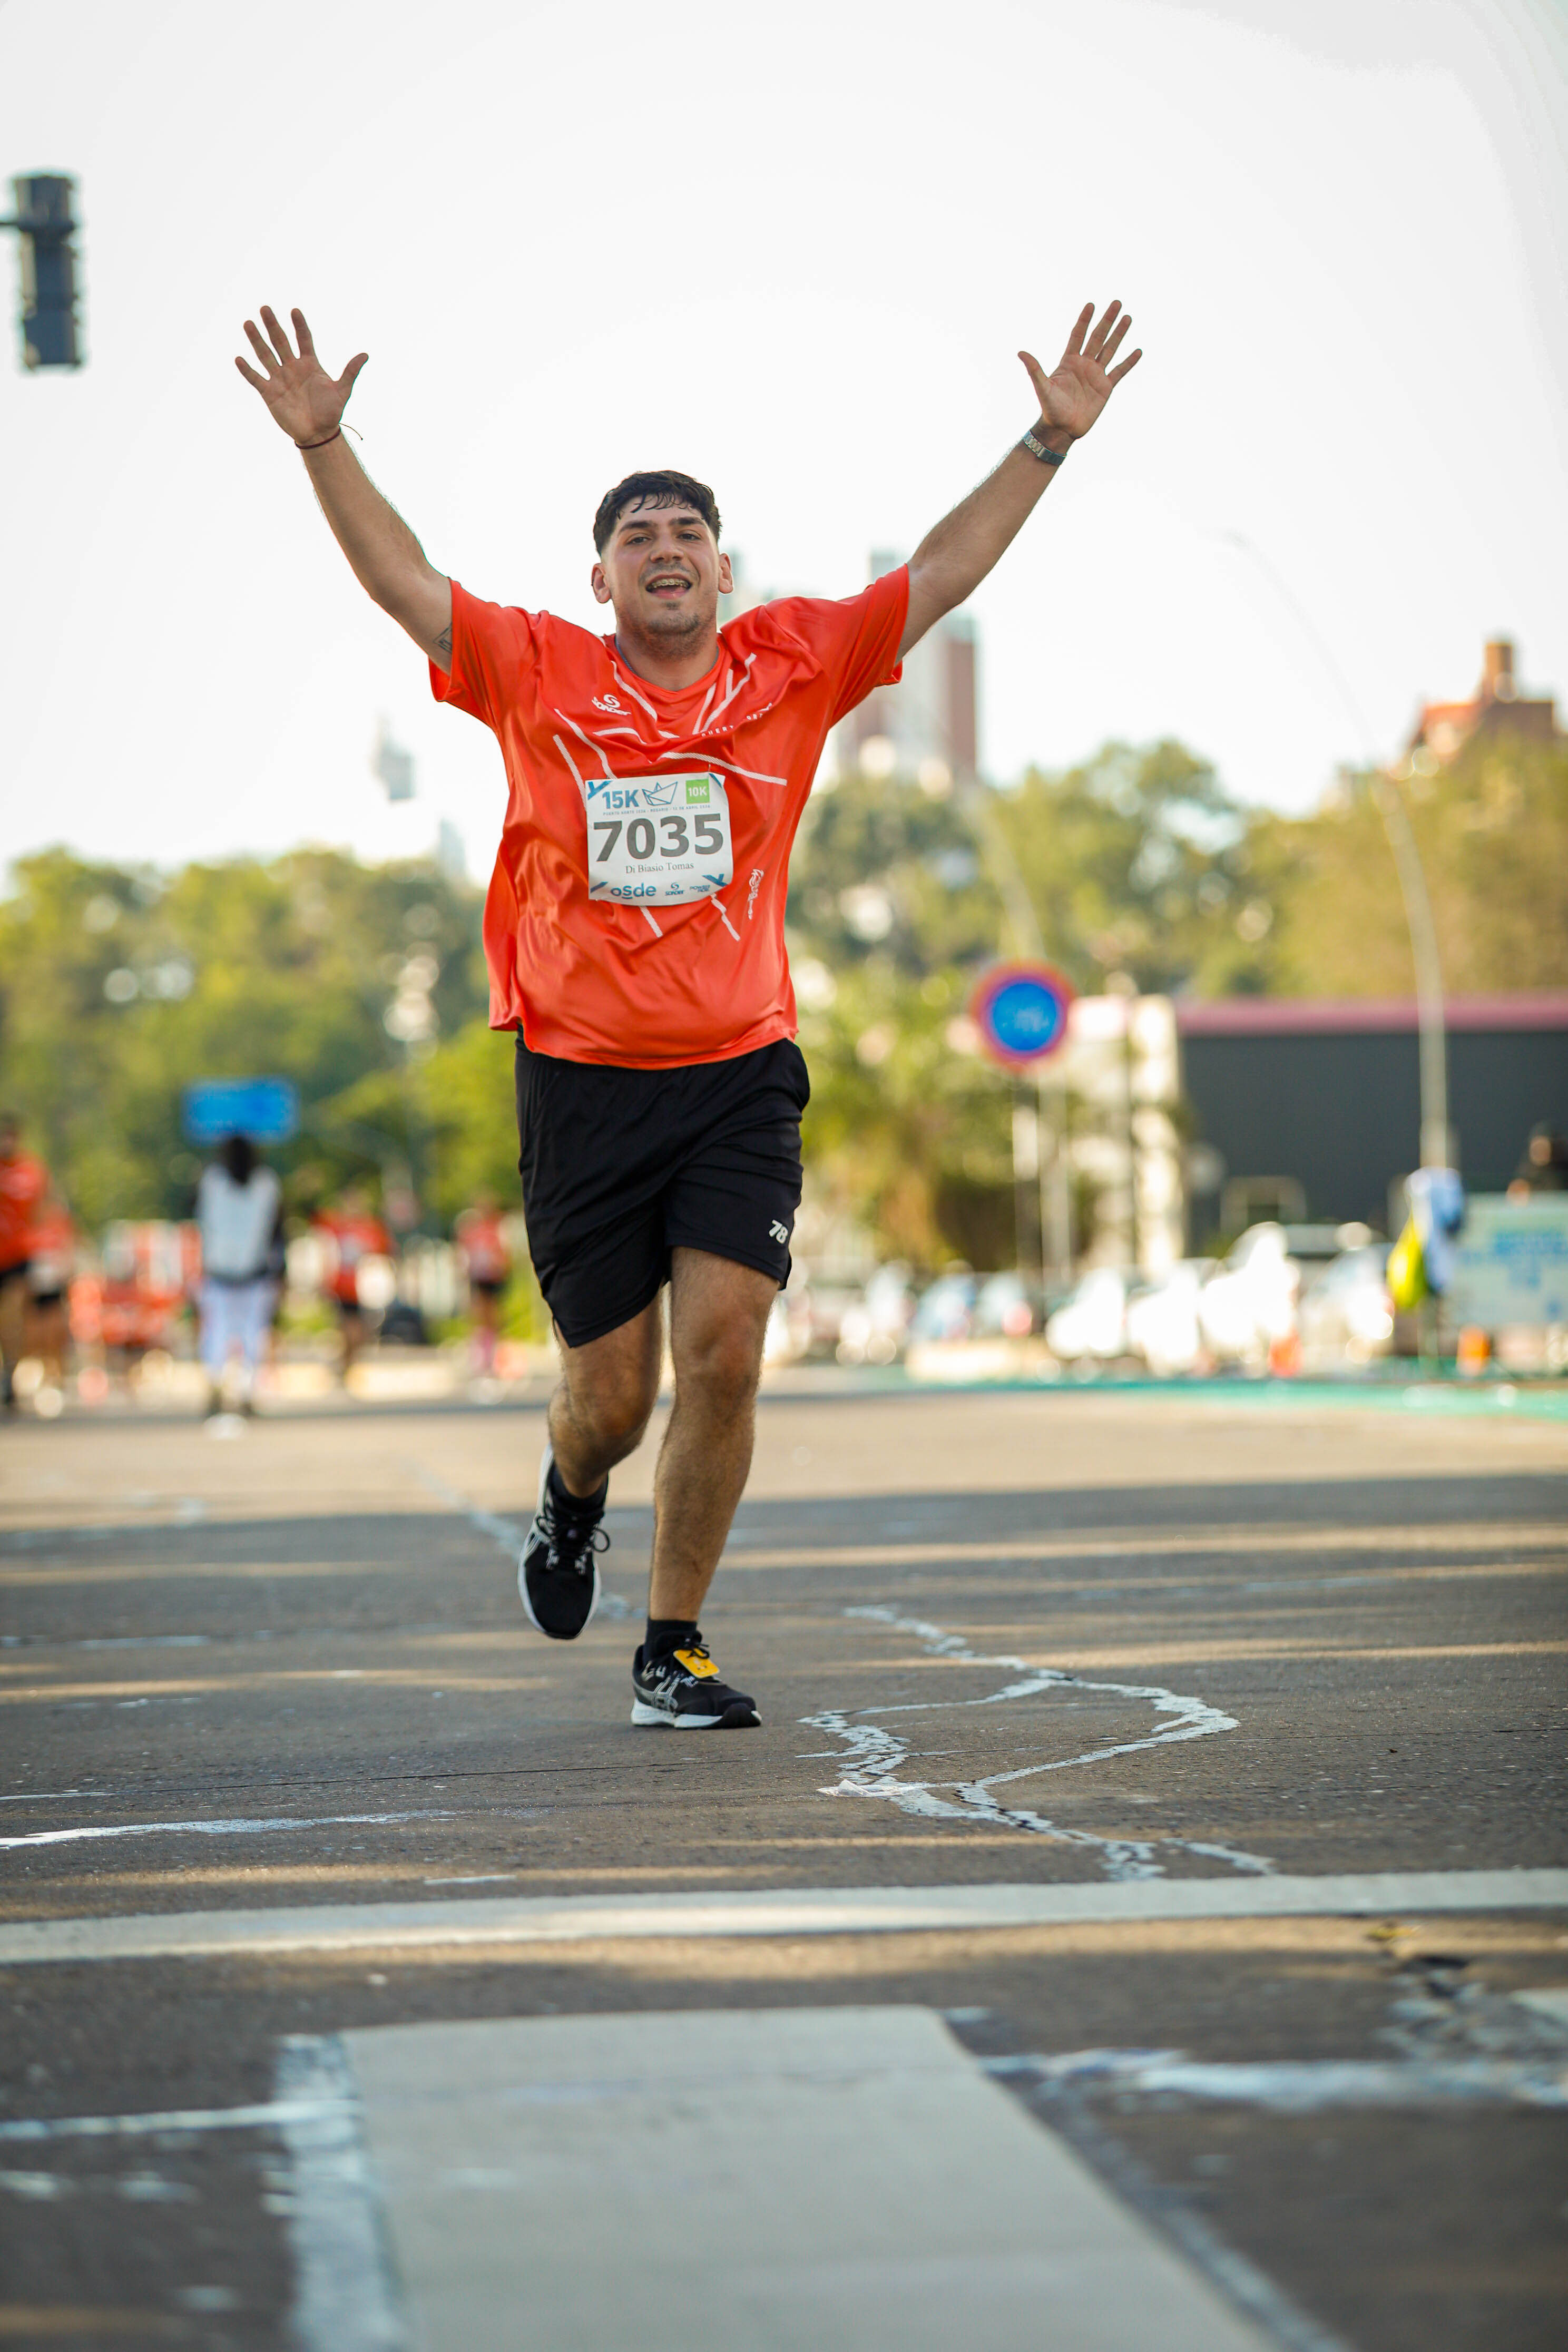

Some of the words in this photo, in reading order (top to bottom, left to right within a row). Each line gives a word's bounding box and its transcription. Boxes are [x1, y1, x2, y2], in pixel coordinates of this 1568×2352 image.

[602, 789, 639, 809] 15K
[689, 787, 707, 797] 10K
[594, 813, 723, 862] 7035
[625, 865, 635, 874] Di
[638, 864, 663, 873] Biasio
[666, 862, 694, 871] Tomas
[611, 883, 656, 899] osde
